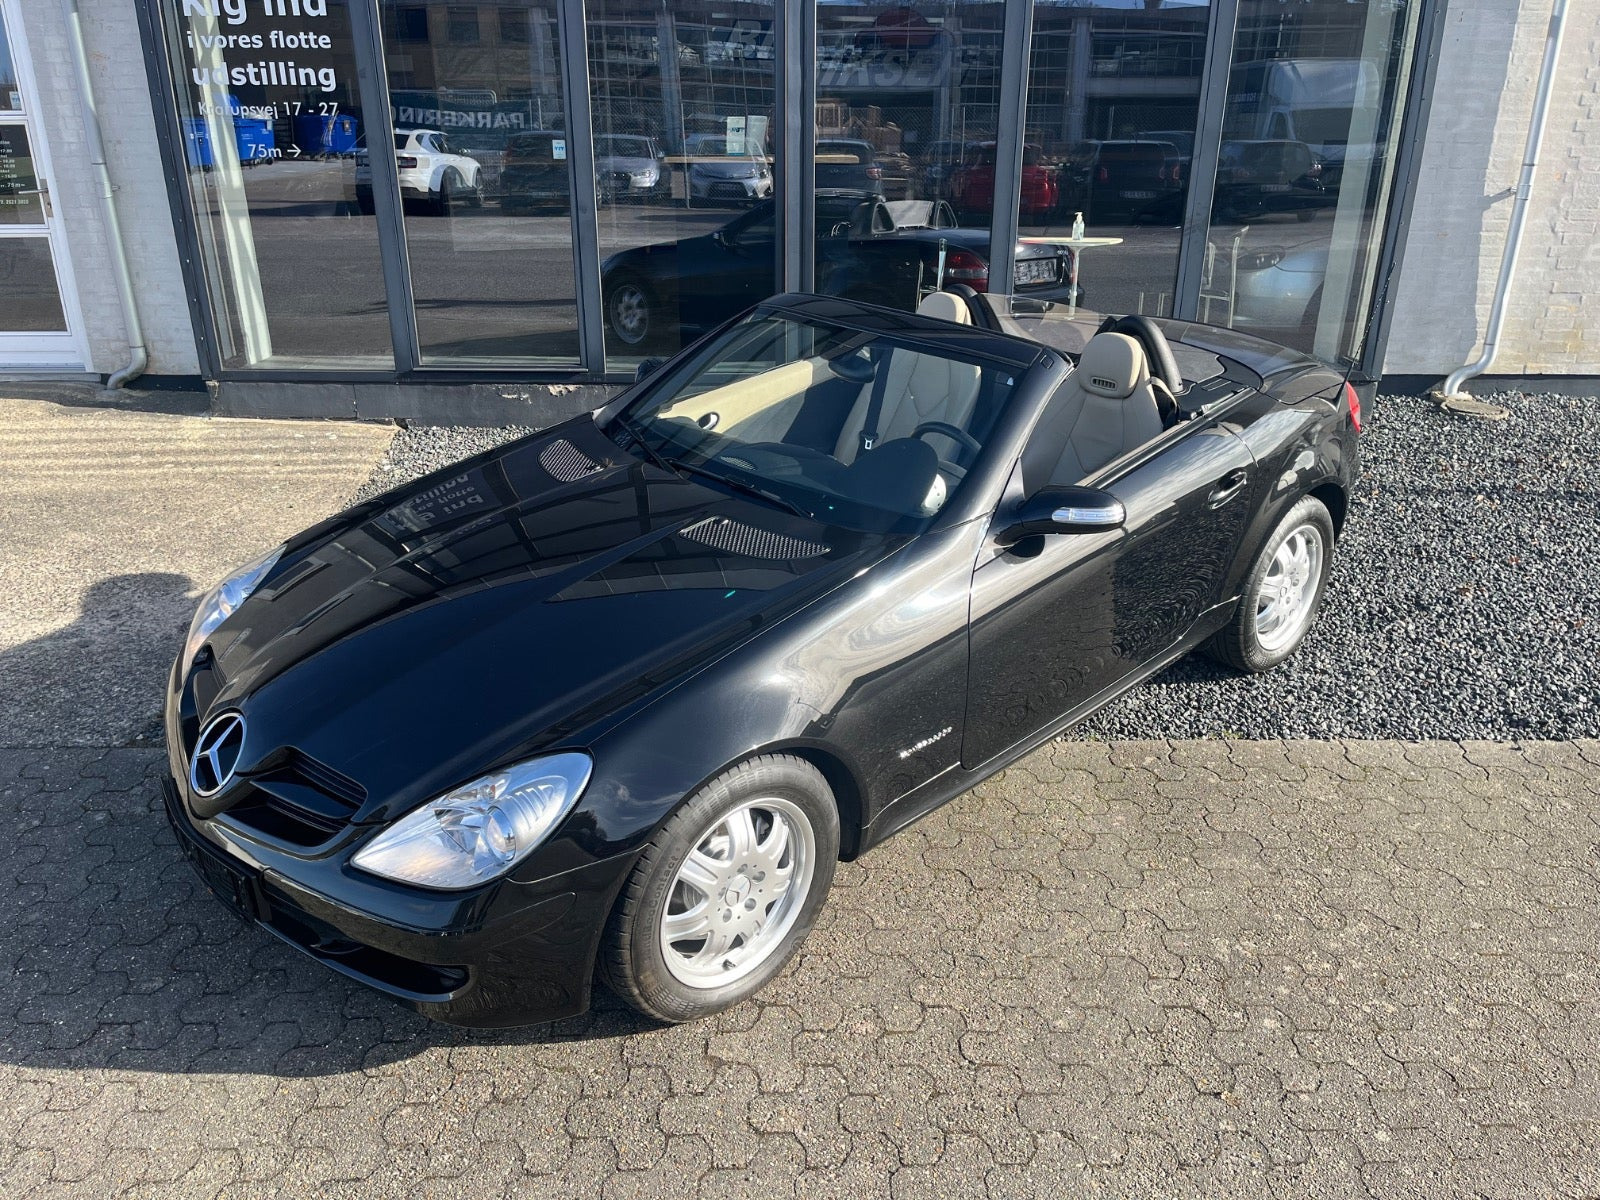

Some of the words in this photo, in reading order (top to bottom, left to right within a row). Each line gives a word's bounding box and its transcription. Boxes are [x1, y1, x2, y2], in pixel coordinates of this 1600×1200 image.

[182, 0, 247, 25] Kig
[186, 31, 194, 48] i
[200, 34, 264, 49] vores
[269, 30, 332, 49] flotte
[192, 61, 337, 92] udstilling
[283, 101, 301, 117] 17
[318, 101, 339, 117] 27
[247, 143, 282, 158] 75m
